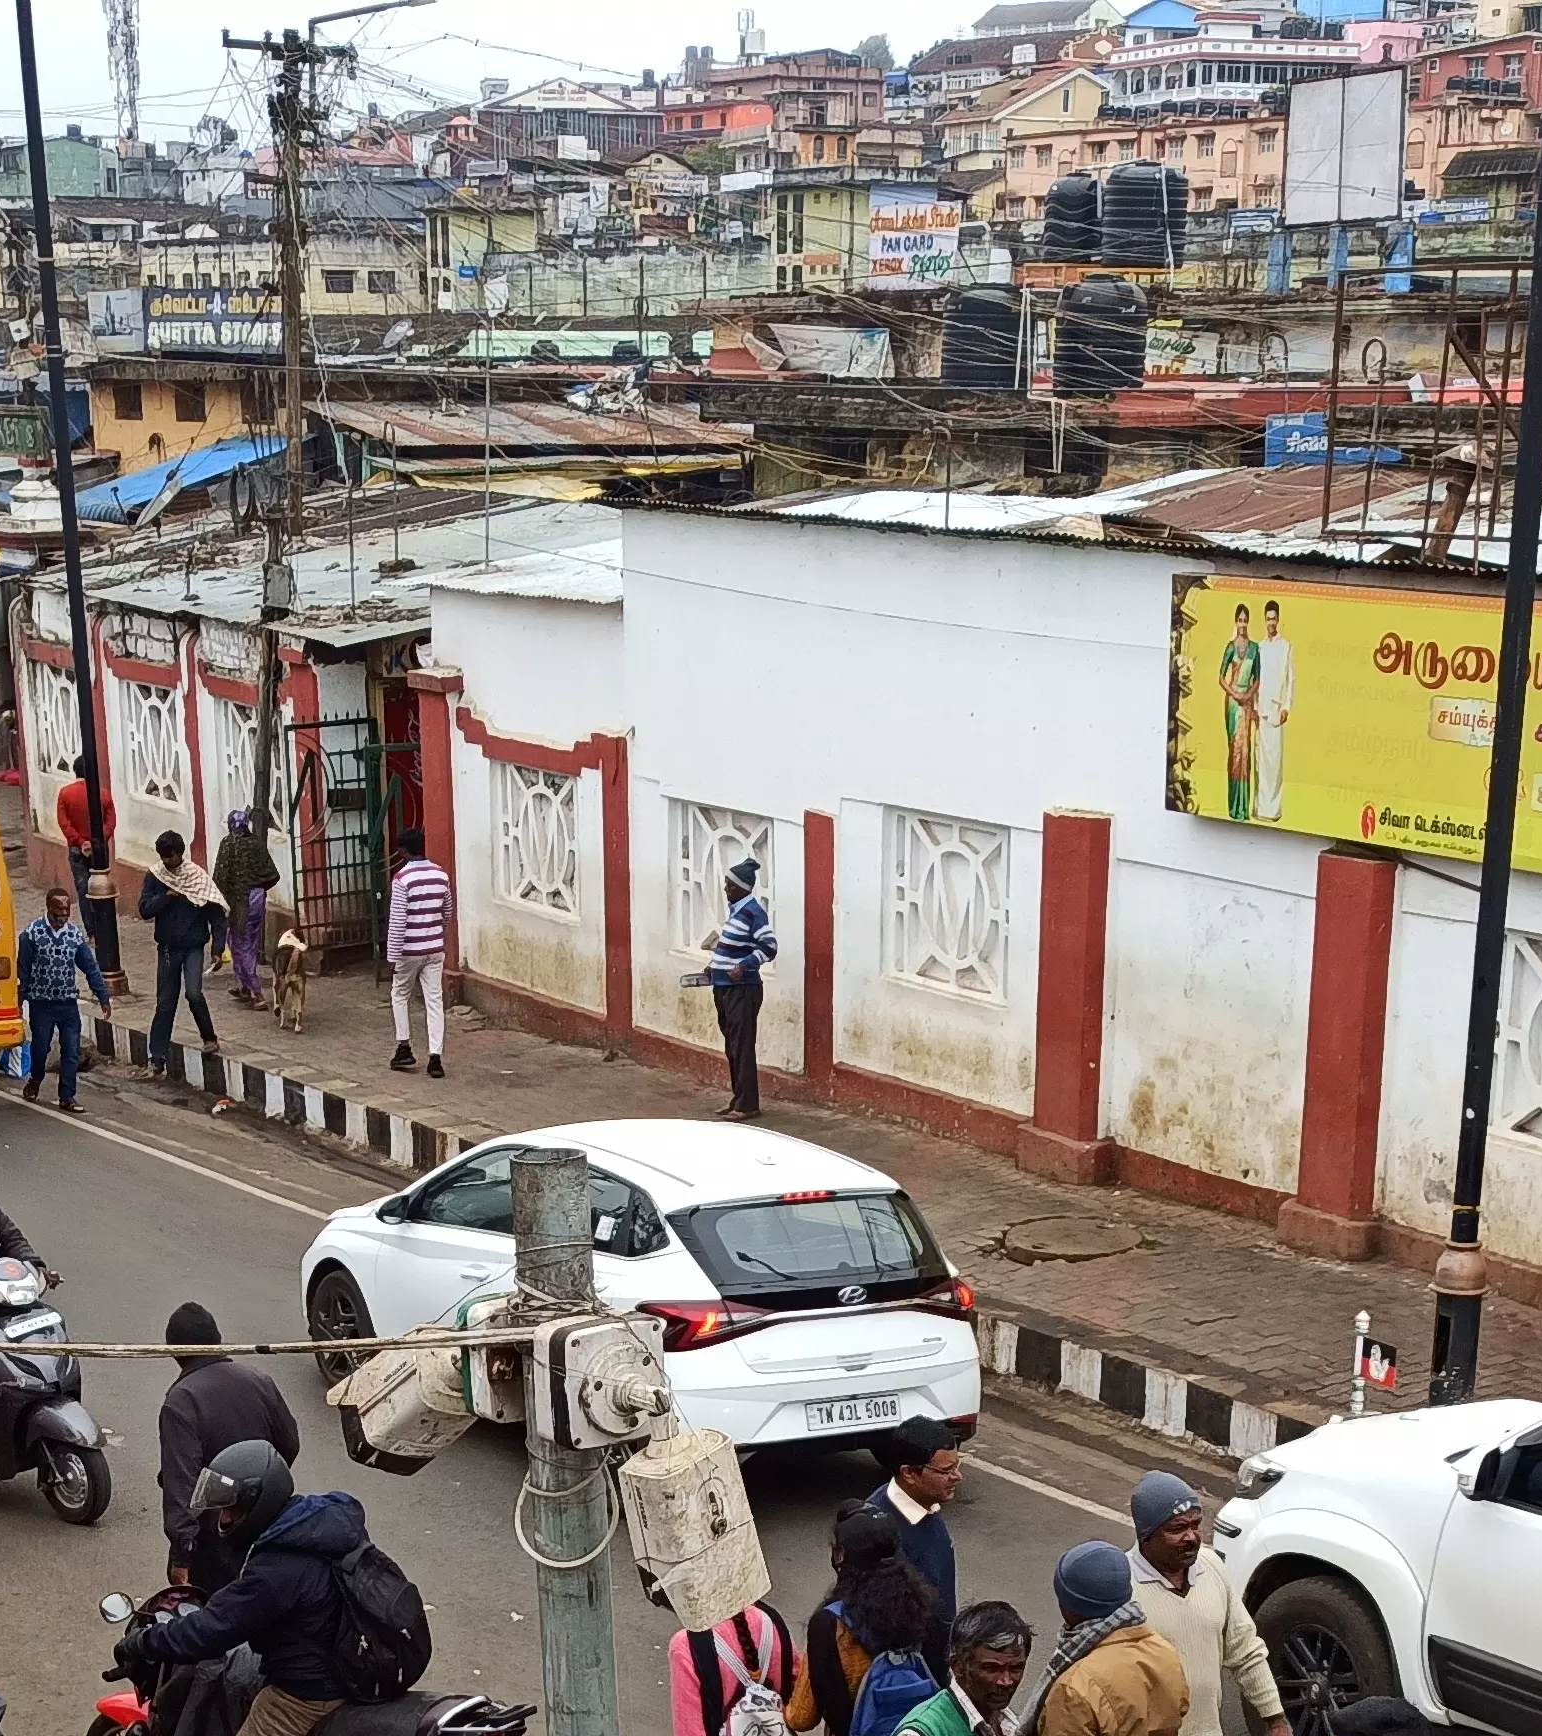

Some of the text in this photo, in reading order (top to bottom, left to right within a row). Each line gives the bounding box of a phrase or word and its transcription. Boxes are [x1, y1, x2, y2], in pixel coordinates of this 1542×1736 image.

[881, 235, 934, 253] PAN CARD
[871, 257, 904, 275] XEROX
[865, 1399, 897, 1419] 5008
